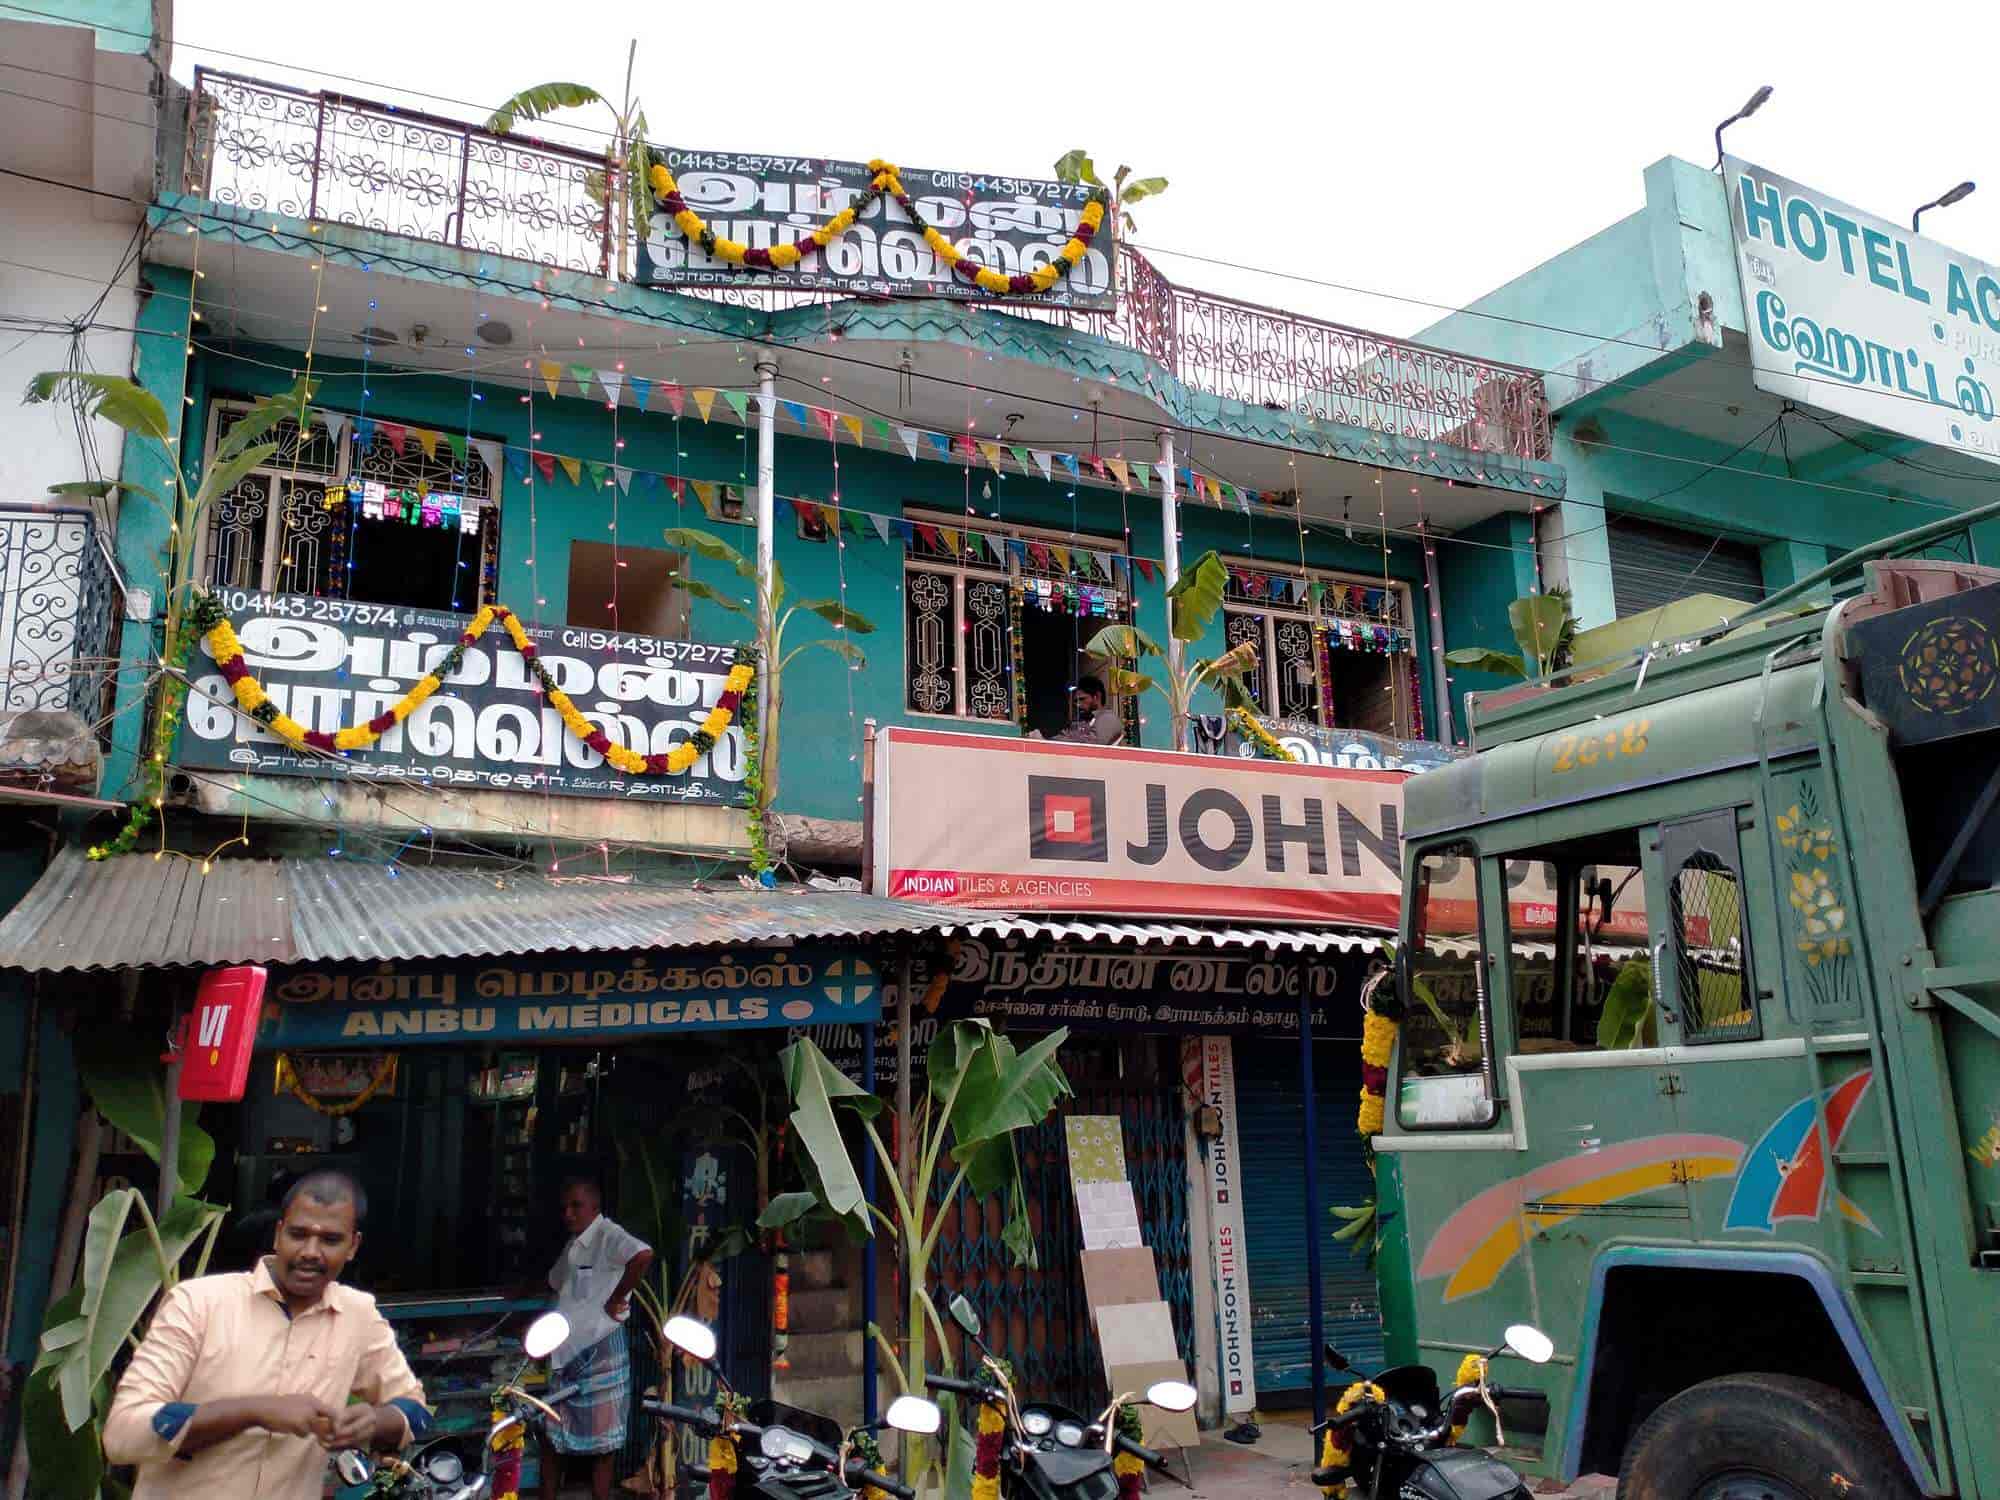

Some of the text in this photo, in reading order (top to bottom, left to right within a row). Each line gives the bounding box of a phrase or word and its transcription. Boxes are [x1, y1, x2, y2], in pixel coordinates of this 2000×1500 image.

[1740, 175, 1931, 304] HOTEL
[1756, 290, 1994, 421] ஹோட்டல்
[588, 633, 736, 665] 9443157273
[904, 876, 1093, 898] INDIAN TILES & AGENCIES
[276, 963, 457, 1005] அன்பு
[951, 937, 1160, 995] இந்தியன்
[1170, 950, 1337, 996] டைல்ஸ்
[341, 998, 769, 1037] ANBU MEDICALS
